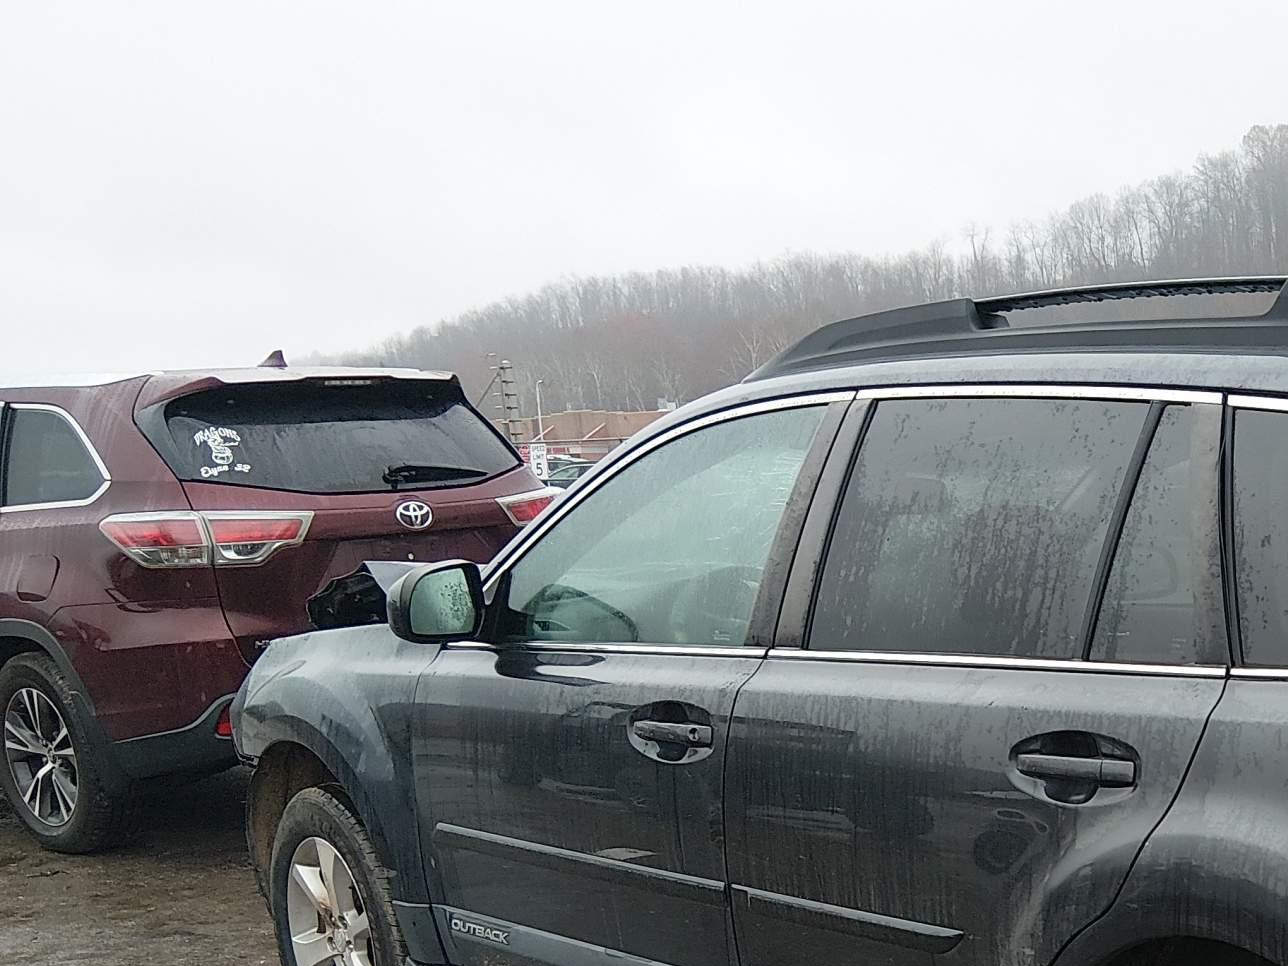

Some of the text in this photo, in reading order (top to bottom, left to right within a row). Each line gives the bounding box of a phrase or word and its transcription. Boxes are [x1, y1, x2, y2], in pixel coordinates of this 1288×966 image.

[194, 427, 241, 447] DRAGONS
[536, 463, 543, 476] 5
[451, 919, 509, 945] OUTBACK
